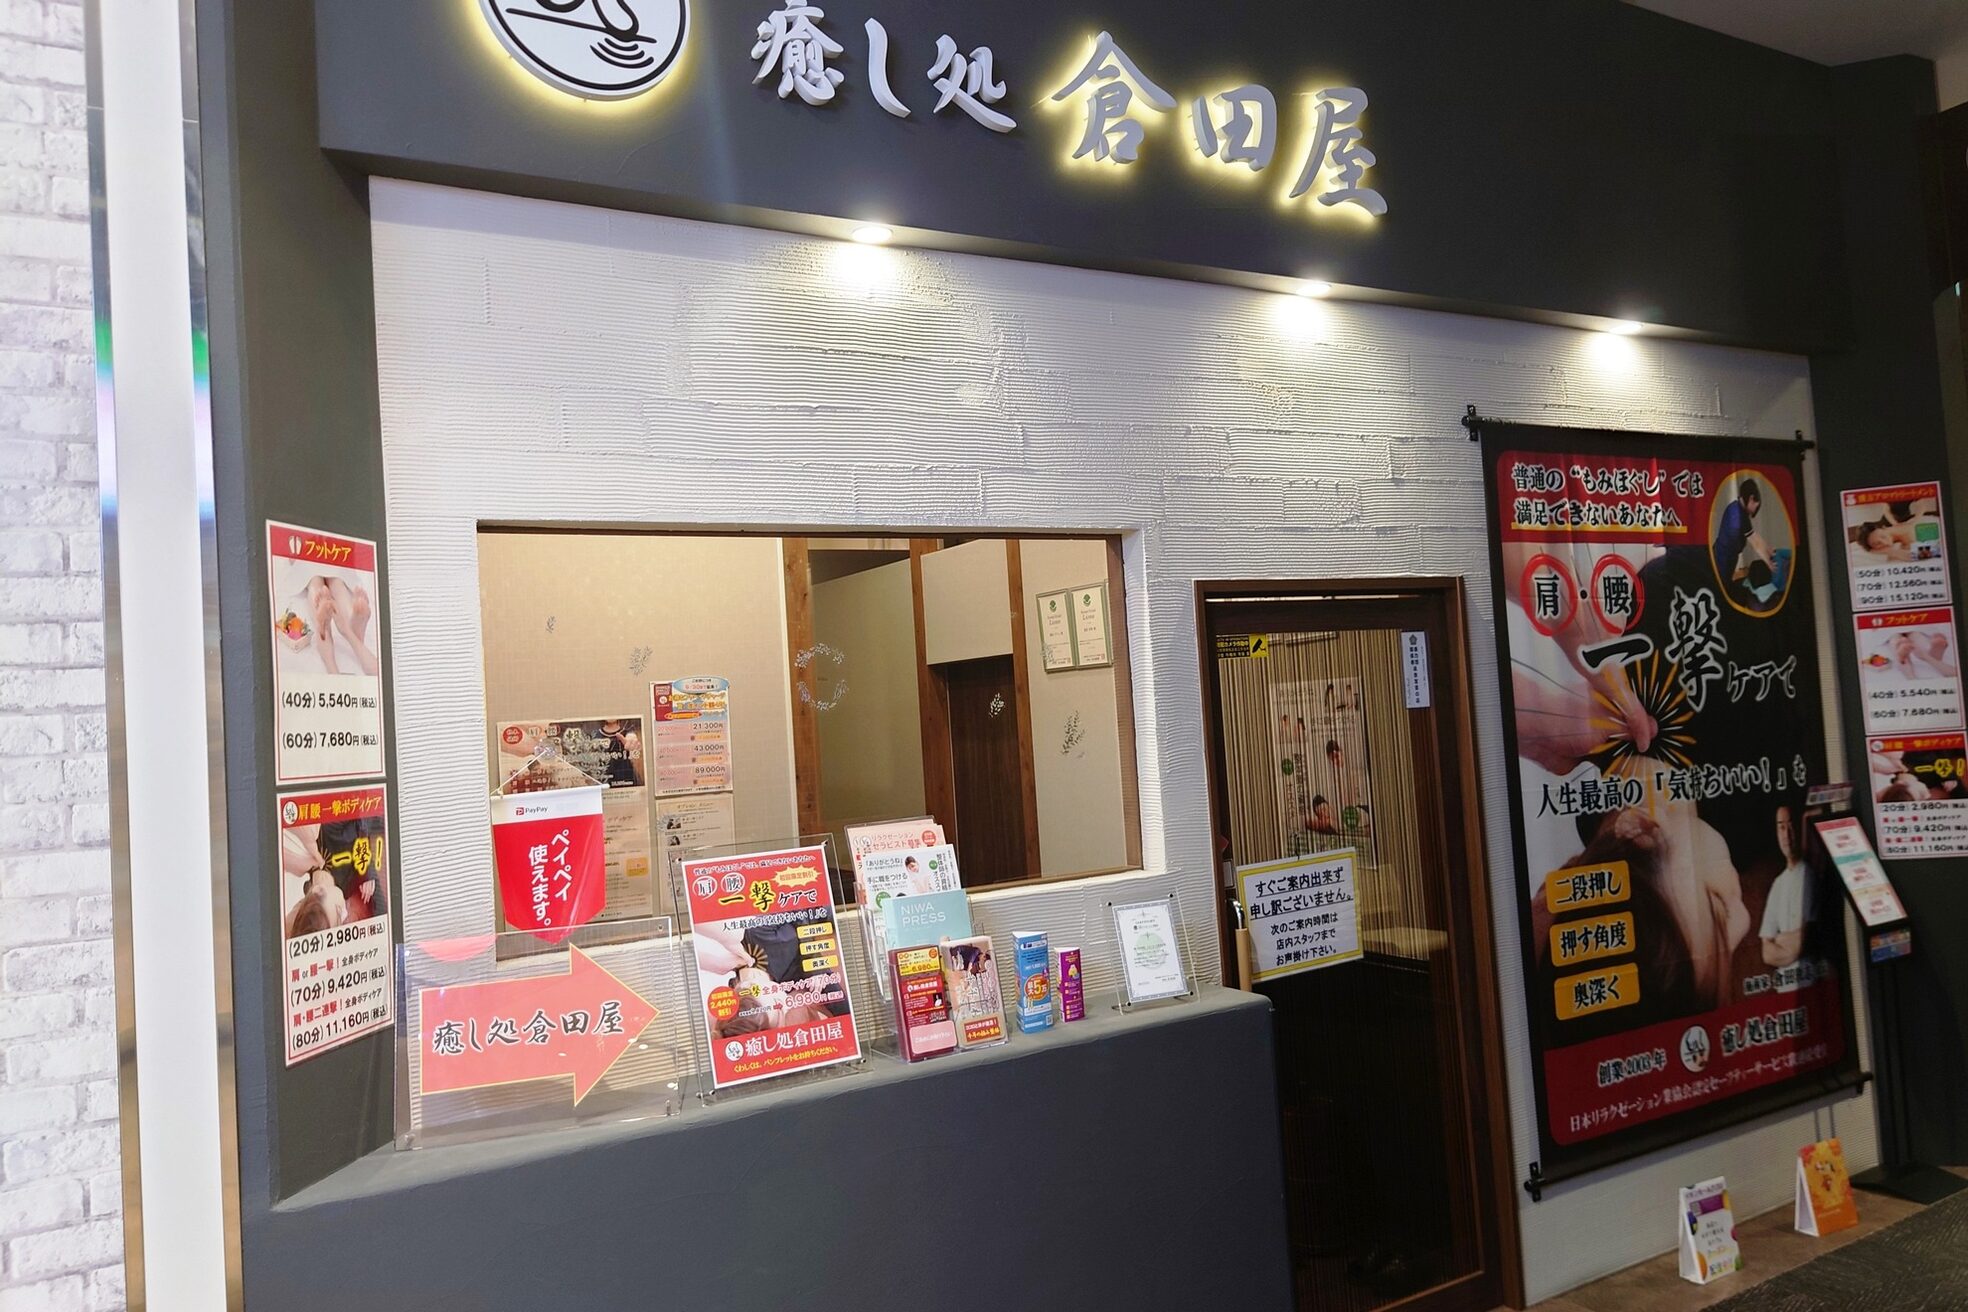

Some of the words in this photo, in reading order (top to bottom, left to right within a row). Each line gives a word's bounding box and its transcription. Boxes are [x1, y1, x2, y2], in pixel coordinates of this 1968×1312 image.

[751, 1, 1017, 132] 癒し処
[1049, 29, 1389, 217] 倉田屋
[1515, 500, 1681, 527] 満足できないあなたへ
[304, 540, 352, 562] フットケア
[282, 692, 316, 709] (40分)
[283, 731, 318, 749] (60分)
[525, 806, 549, 815] PayPay
[551, 829, 571, 902] ペイペイ
[528, 844, 552, 927] 使えます。
[1255, 866, 1344, 897] すぐご案内出来ず
[1555, 870, 1623, 904] 二段押し
[901, 902, 935, 916] NIWA
[1250, 888, 1353, 917] 申し訳ございません。
[902, 911, 946, 927] PRESS
[1271, 912, 1339, 936] 次のご案内時間は
[289, 934, 324, 959] (20分)
[805, 942, 831, 955] 押す角度
[1276, 929, 1336, 950] 店内スタッフまで
[1560, 921, 1627, 959] 押す角度
[1276, 945, 1337, 966] お声掛け下さい。
[291, 980, 326, 1007] (70分)
[710, 998, 737, 1009] 2,440円
[1574, 975, 1621, 1009] 奥深く
[292, 1024, 324, 1050] (80分)
[433, 1001, 624, 1055] 癒し処倉田屋
[745, 1021, 844, 1057] 癒し処倉田屋
[1722, 1008, 1809, 1056] 癒し処倉田屋
